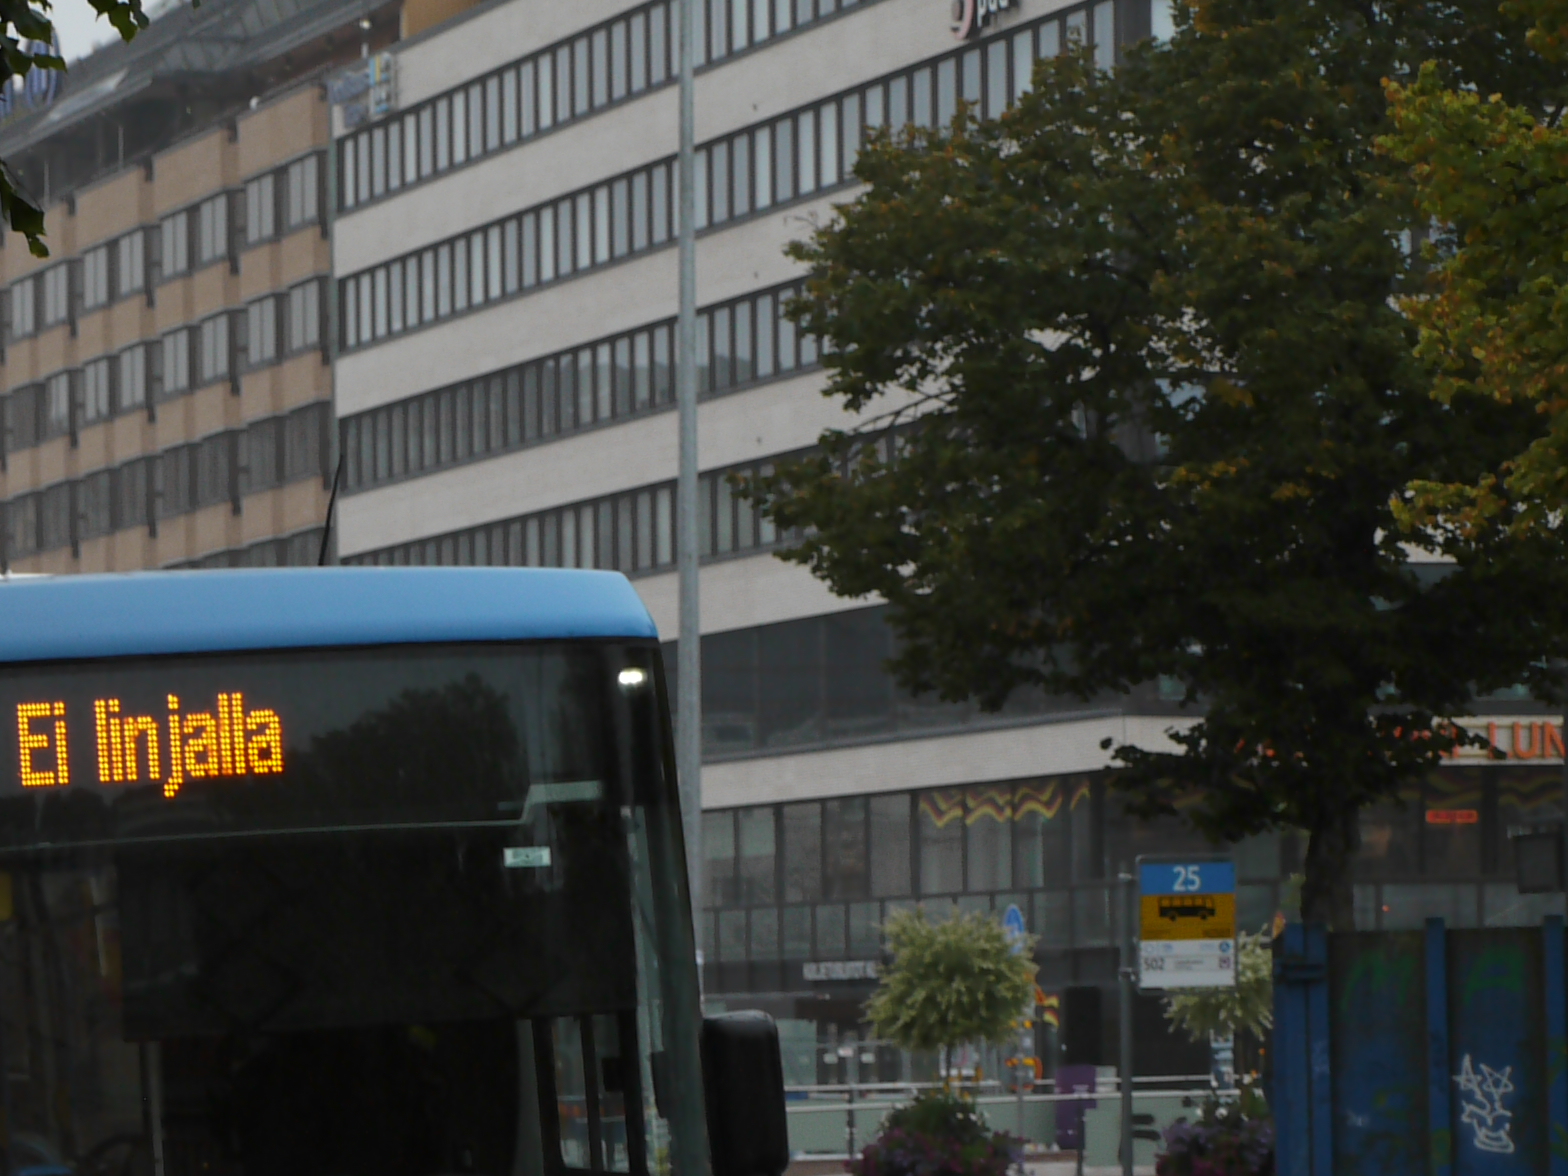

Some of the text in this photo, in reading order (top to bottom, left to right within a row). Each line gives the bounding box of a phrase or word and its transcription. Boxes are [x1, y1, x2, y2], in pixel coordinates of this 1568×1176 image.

[17, 692, 285, 799] Ei linjalla
[1172, 865, 1202, 892] 25
